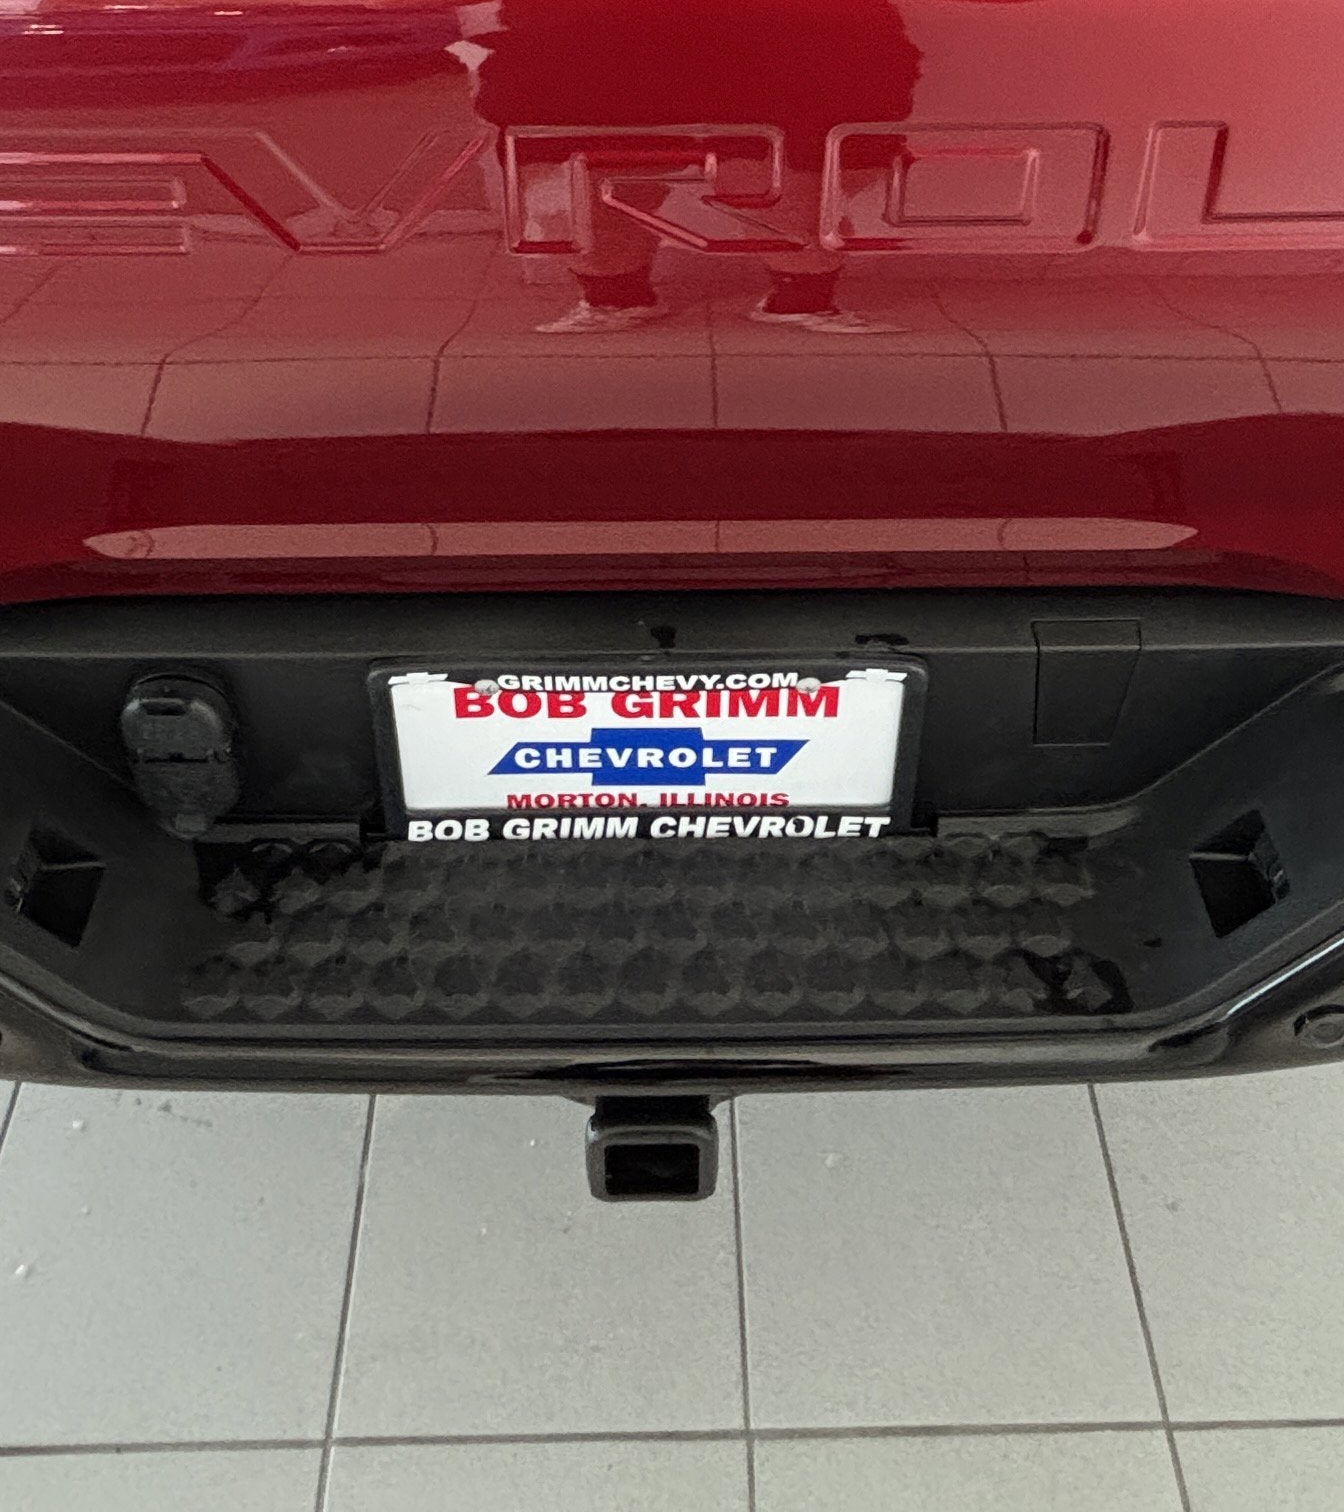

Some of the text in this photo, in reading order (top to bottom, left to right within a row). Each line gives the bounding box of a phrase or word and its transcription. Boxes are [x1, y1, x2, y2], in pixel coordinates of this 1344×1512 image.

[497, 673, 798, 692] GRIMMCHEVY.COM
[454, 687, 840, 719] BOB GRIMM
[514, 747, 777, 769] CHEVROLET
[659, 792, 790, 808] ILLINOIS
[408, 816, 891, 842] BOB GRIMM CHEVROLET
